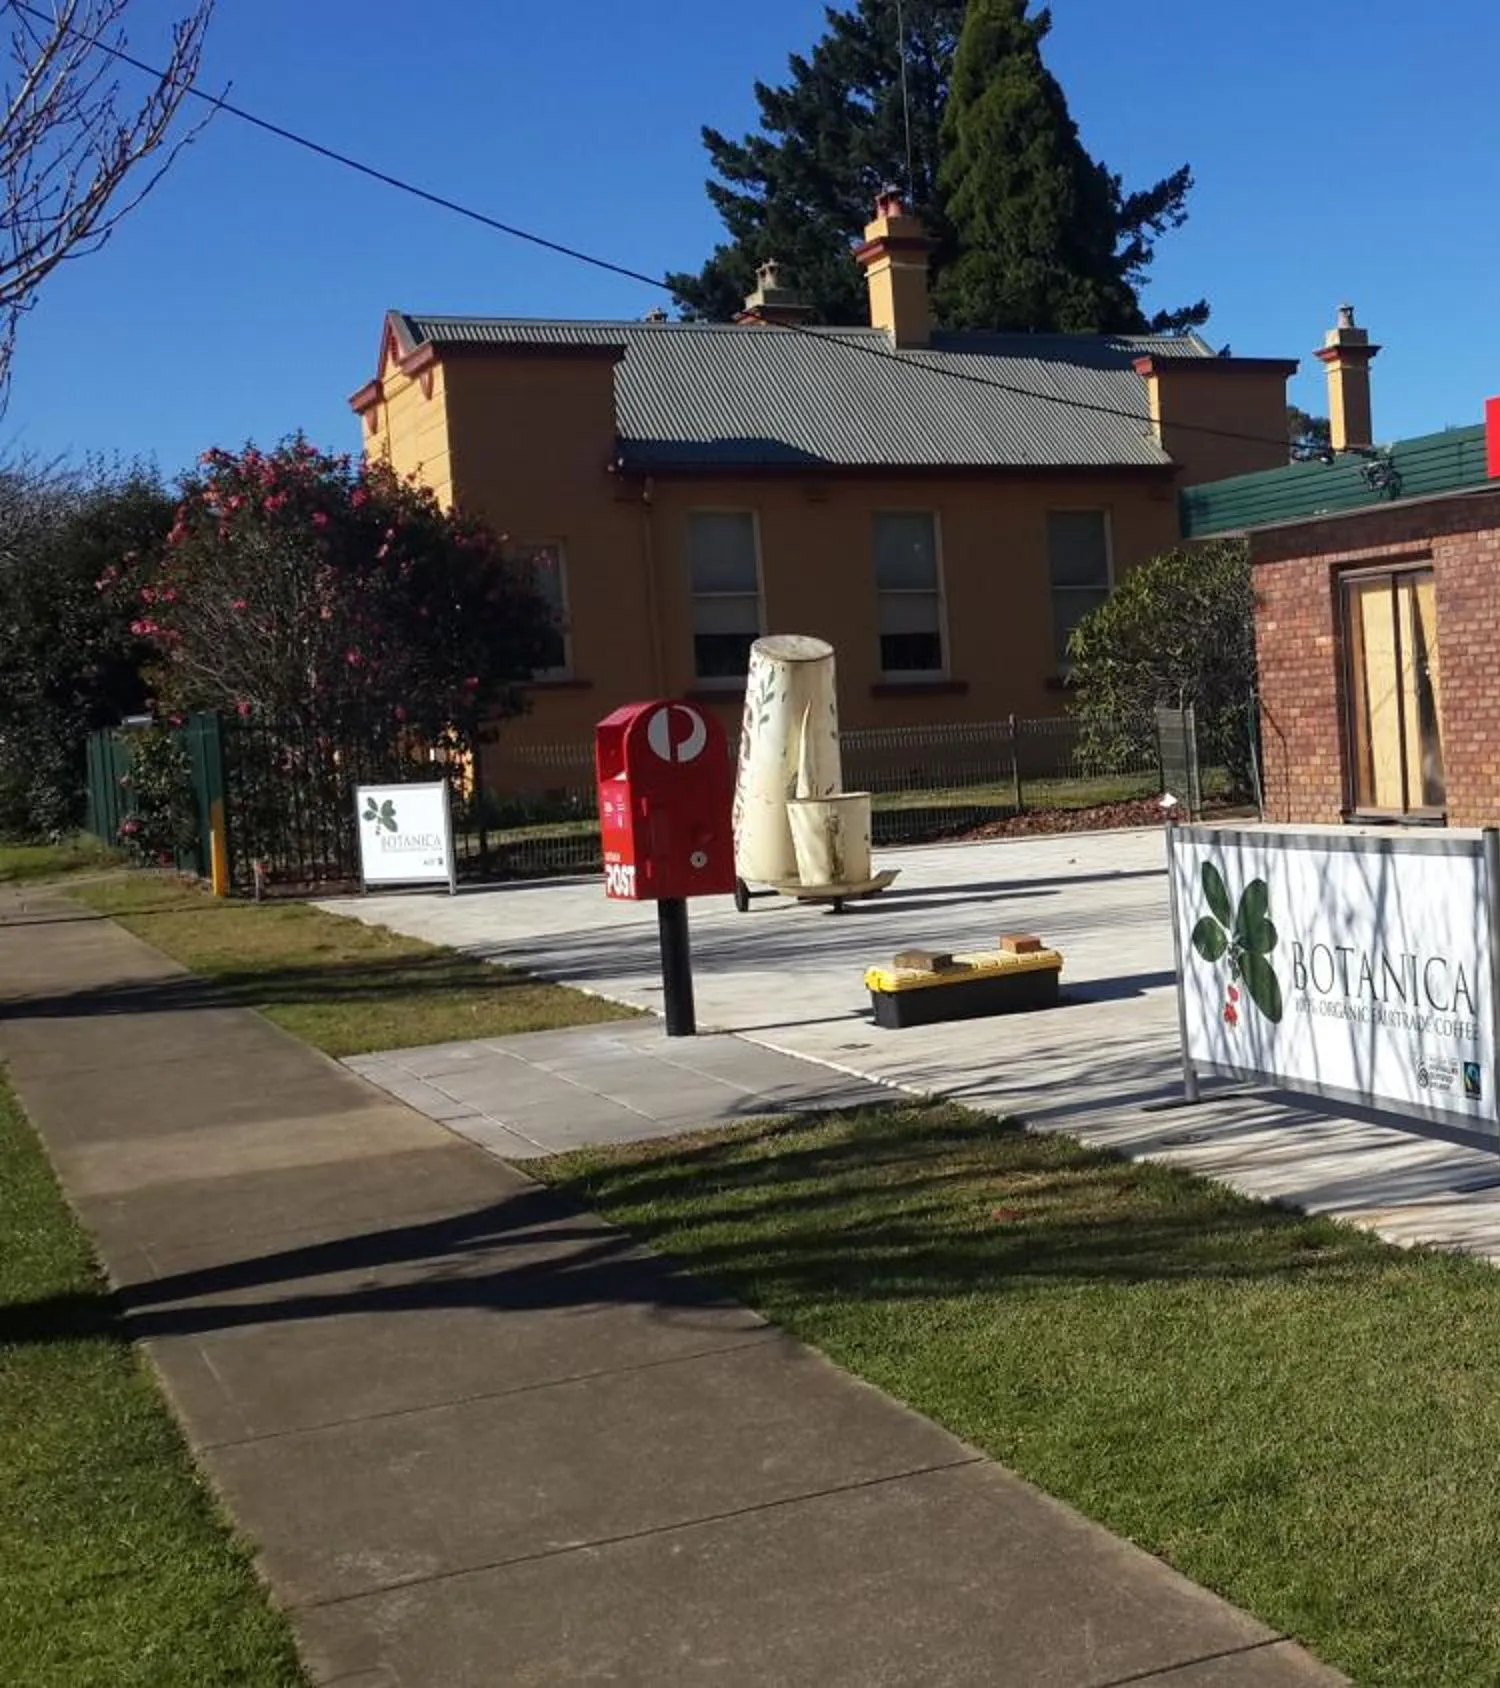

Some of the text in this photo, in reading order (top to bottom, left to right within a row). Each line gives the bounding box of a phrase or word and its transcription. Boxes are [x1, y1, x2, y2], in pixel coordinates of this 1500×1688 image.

[381, 833, 442, 849] BOTANICA
[605, 864, 636, 897] POST
[1291, 941, 1476, 1016] BOTANICA
